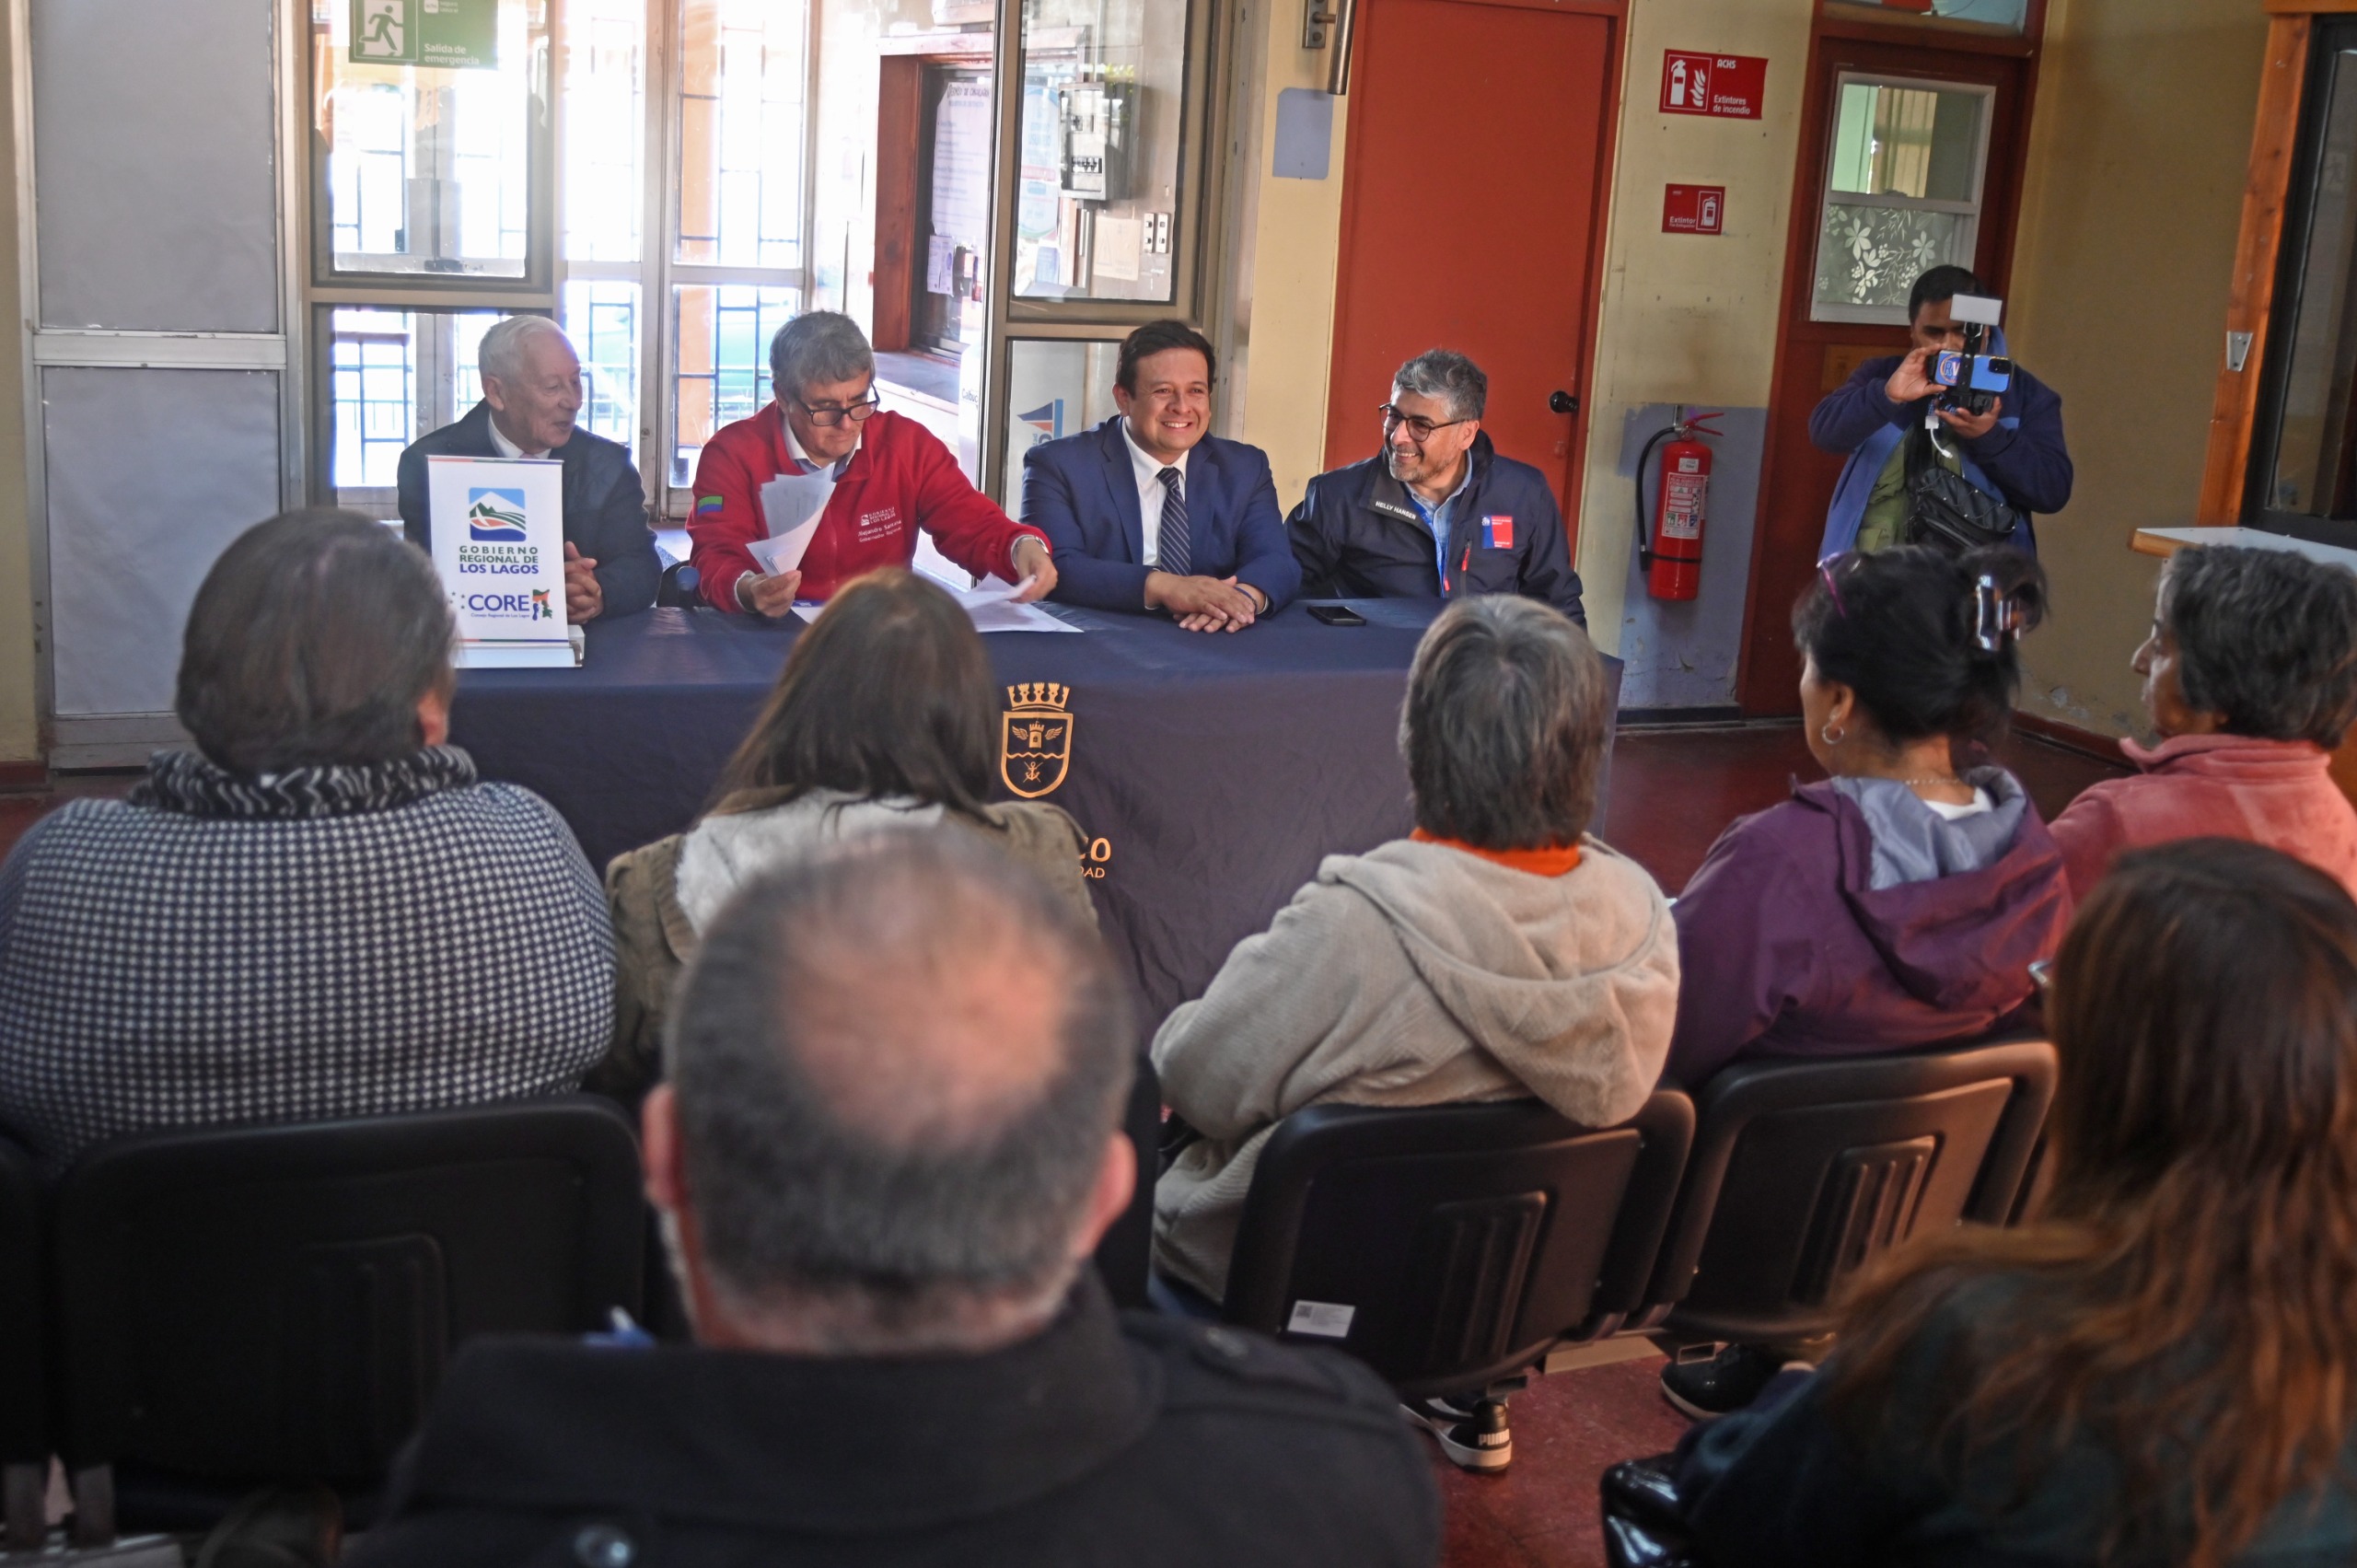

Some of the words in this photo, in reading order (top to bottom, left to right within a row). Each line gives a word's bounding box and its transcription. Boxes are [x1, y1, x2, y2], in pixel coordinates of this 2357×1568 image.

[424, 43, 453, 53] Salida
[455, 45, 467, 54] de
[424, 55, 480, 65] emergencia
[1717, 59, 1736, 69] ACHS
[1713, 95, 1747, 106] Extintores
[1713, 104, 1722, 112] de
[1723, 105, 1750, 115] incendio
[1669, 216, 1696, 225] Extintor
[1375, 501, 1394, 511] HELLY
[1394, 506, 1417, 520] HANSEN
[459, 545, 539, 555] GOBIERNO
[459, 554, 520, 563] REGIONAL
[524, 555, 539, 563] DE
[459, 563, 487, 574] LOS
[491, 563, 540, 575] LAGOS
[468, 594, 530, 612] CORE
